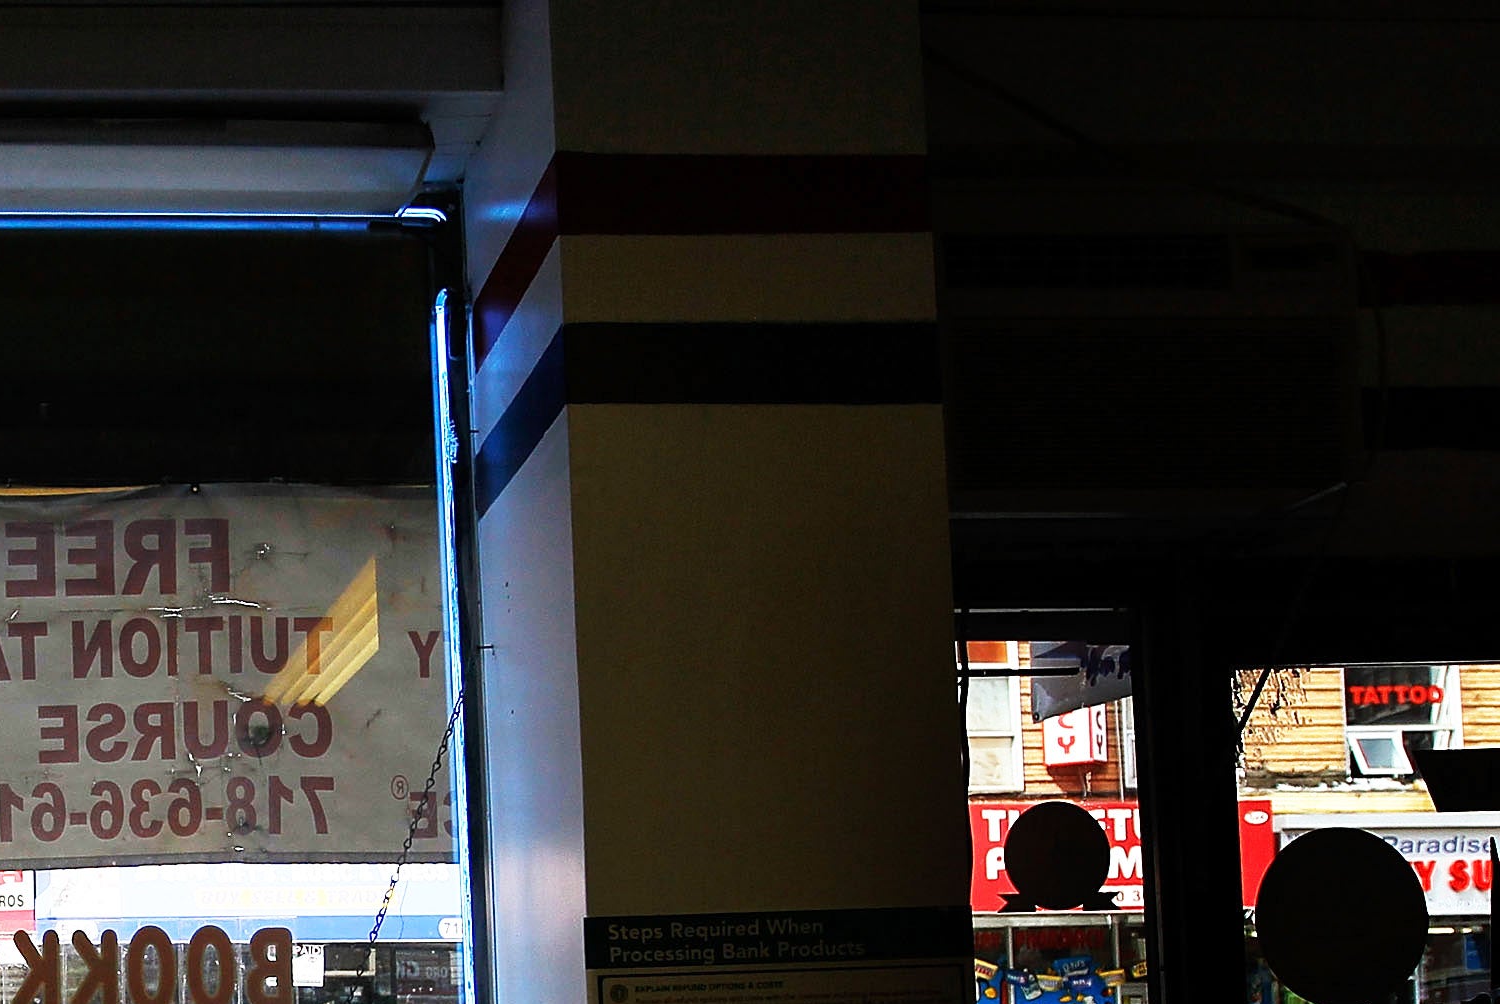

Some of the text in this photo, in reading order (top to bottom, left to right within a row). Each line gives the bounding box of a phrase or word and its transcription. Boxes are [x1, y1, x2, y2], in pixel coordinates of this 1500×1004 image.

[1349, 684, 1444, 706] TATTOO
[607, 917, 825, 945] Steps Required When
[609, 939, 867, 966] Processing Bank Products
